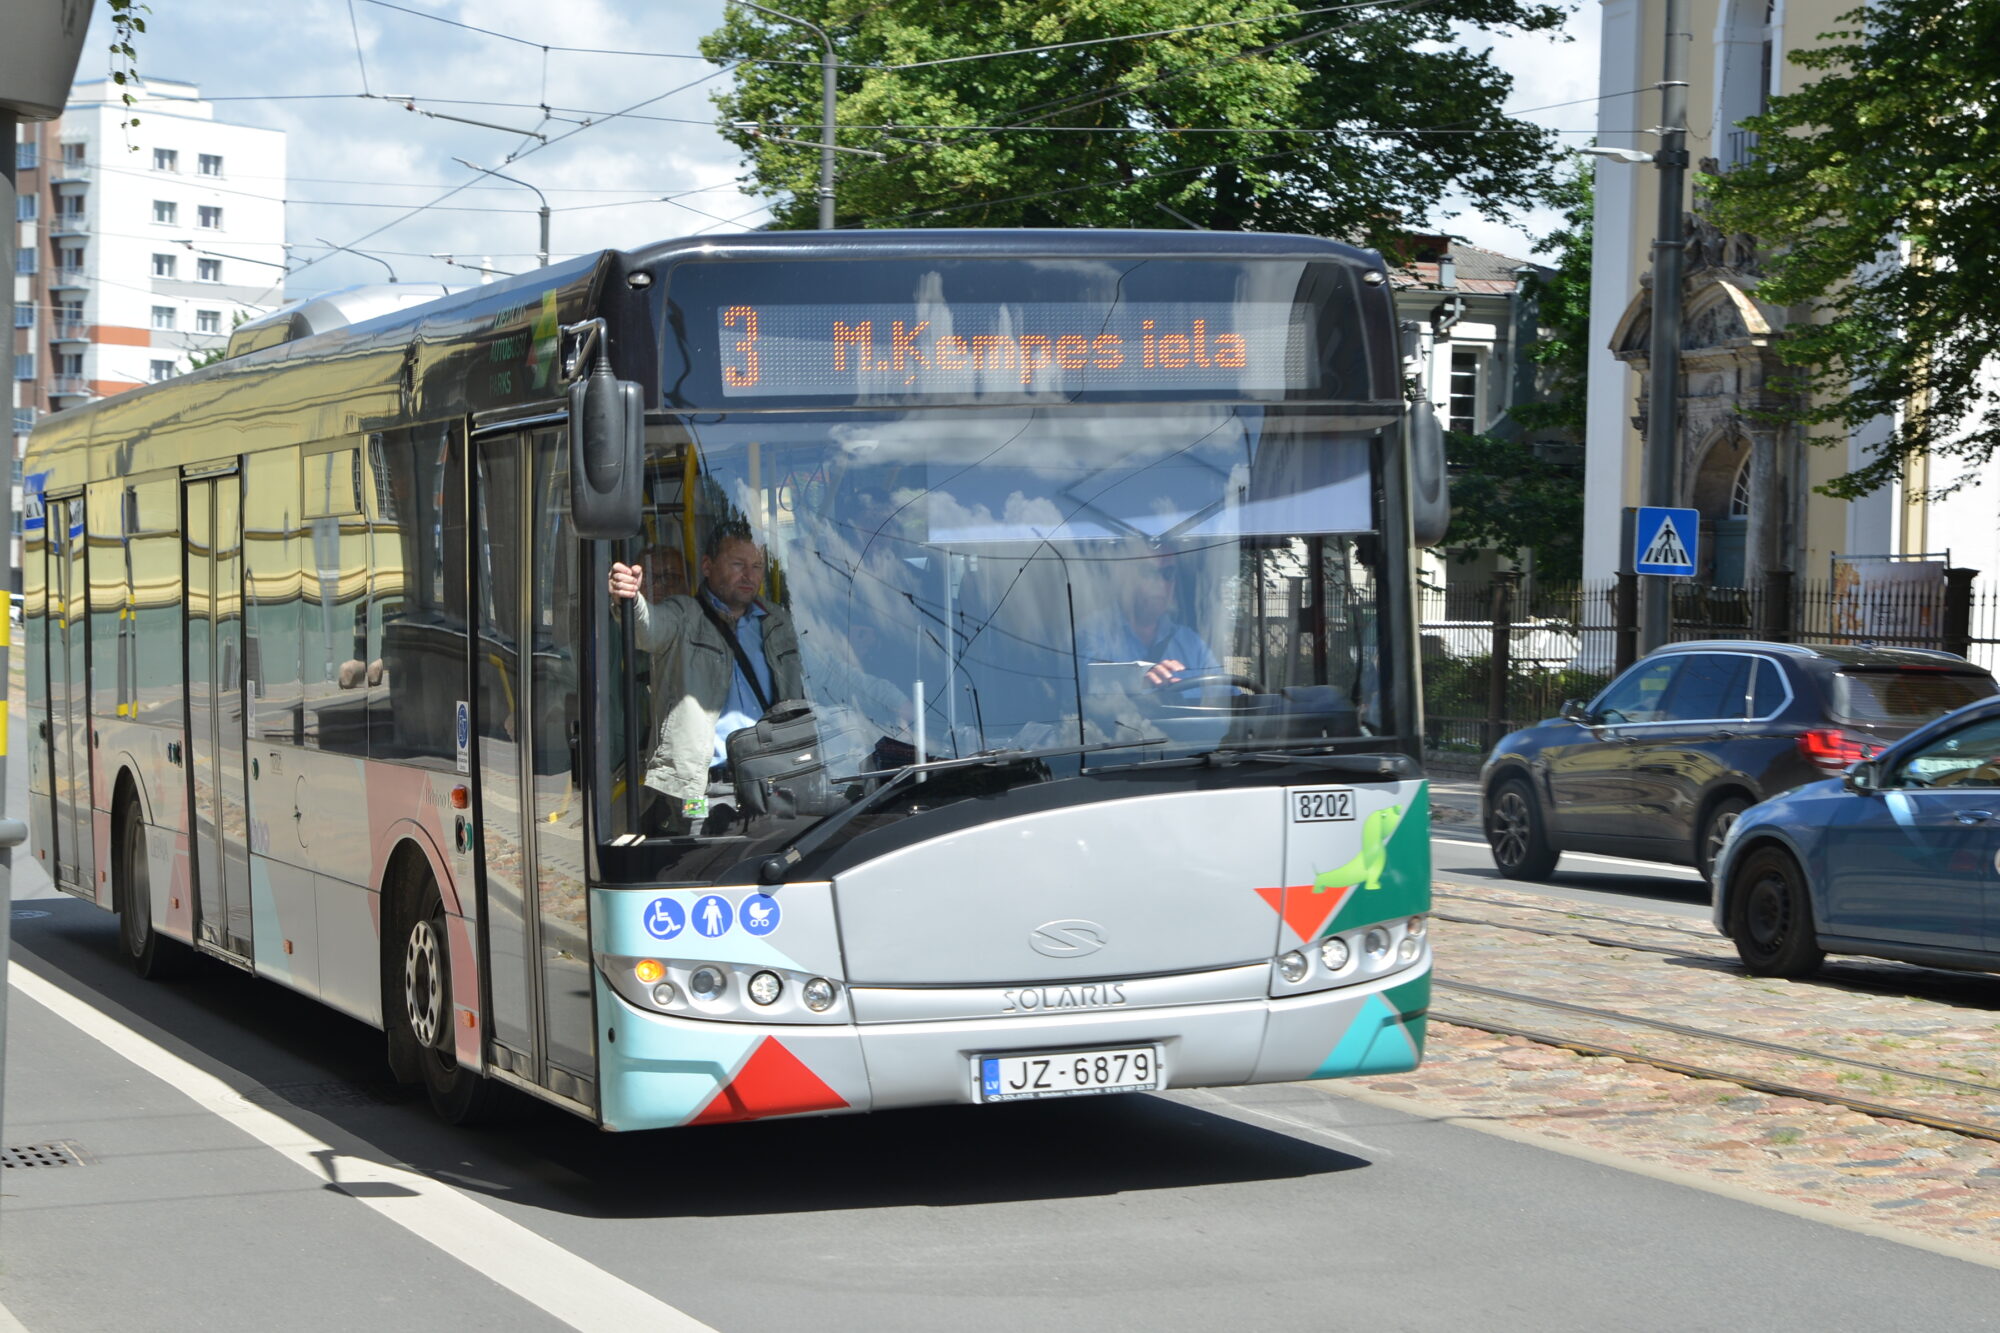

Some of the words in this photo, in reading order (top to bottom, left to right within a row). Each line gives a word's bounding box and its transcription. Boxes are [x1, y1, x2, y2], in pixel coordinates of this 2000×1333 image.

[724, 305, 759, 387] 3
[1142, 319, 1247, 369] iela
[1300, 793, 1350, 818] 8202
[1002, 984, 1126, 1011] SOLARIS
[1009, 1053, 1149, 1090] JZ-6879
[985, 1080, 999, 1091] LV
